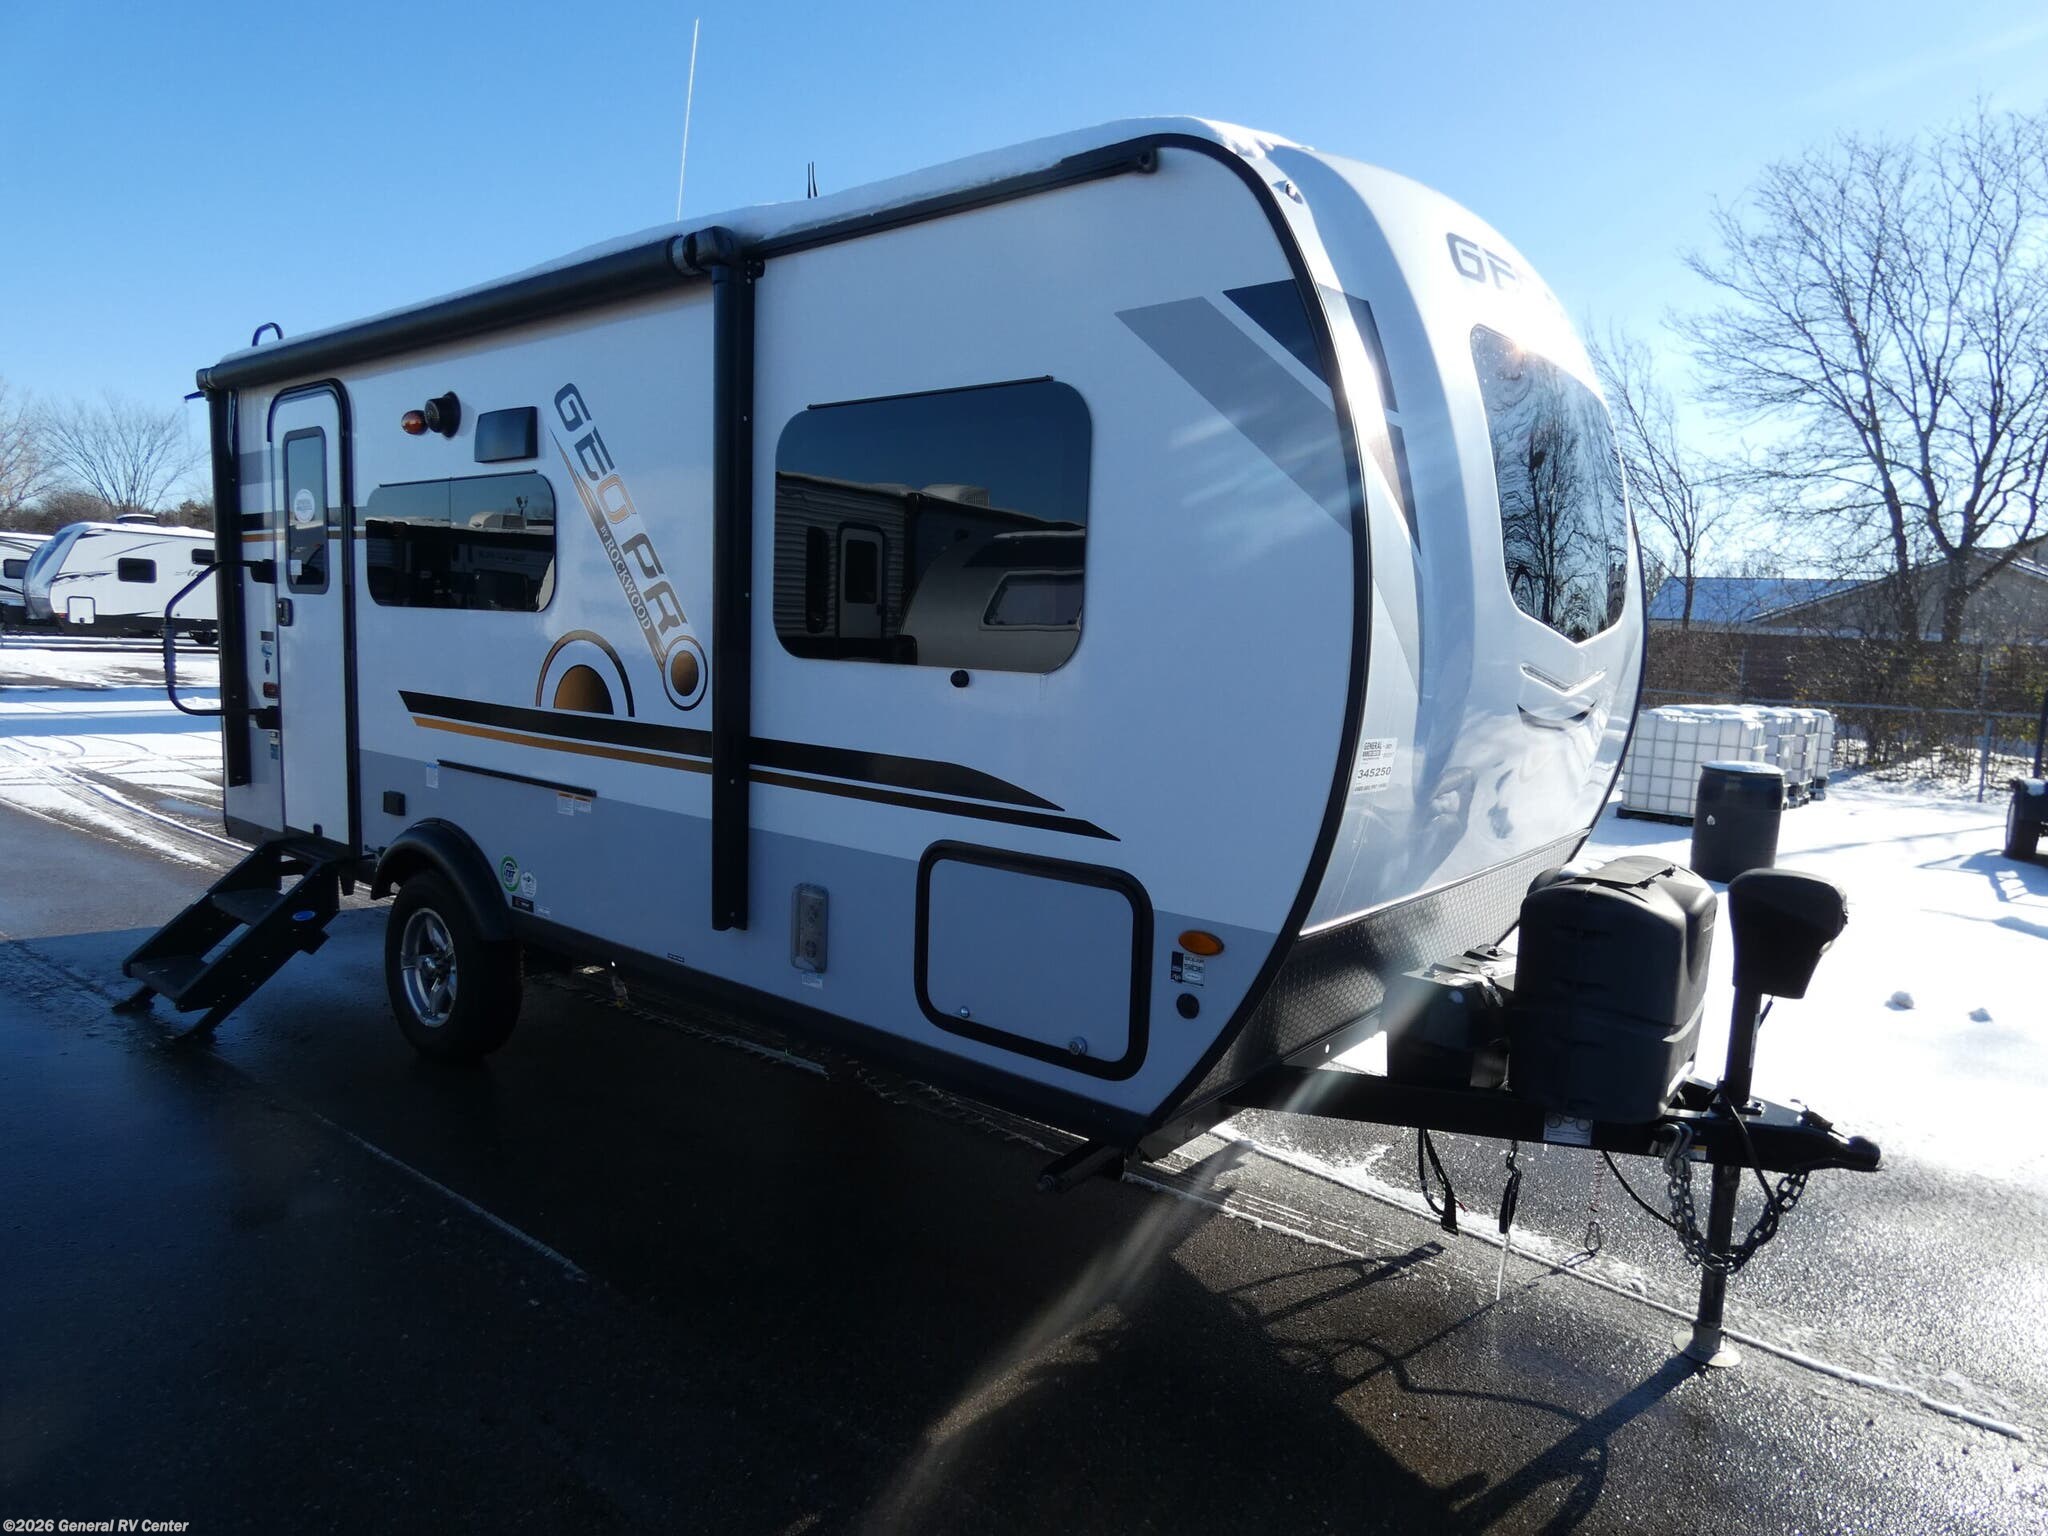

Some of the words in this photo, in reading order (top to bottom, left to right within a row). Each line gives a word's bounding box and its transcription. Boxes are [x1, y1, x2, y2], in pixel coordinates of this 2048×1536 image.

[554, 382, 637, 524] GEO
[605, 538, 652, 631] ROCKWOOD
[1357, 766, 1392, 779] 345250
